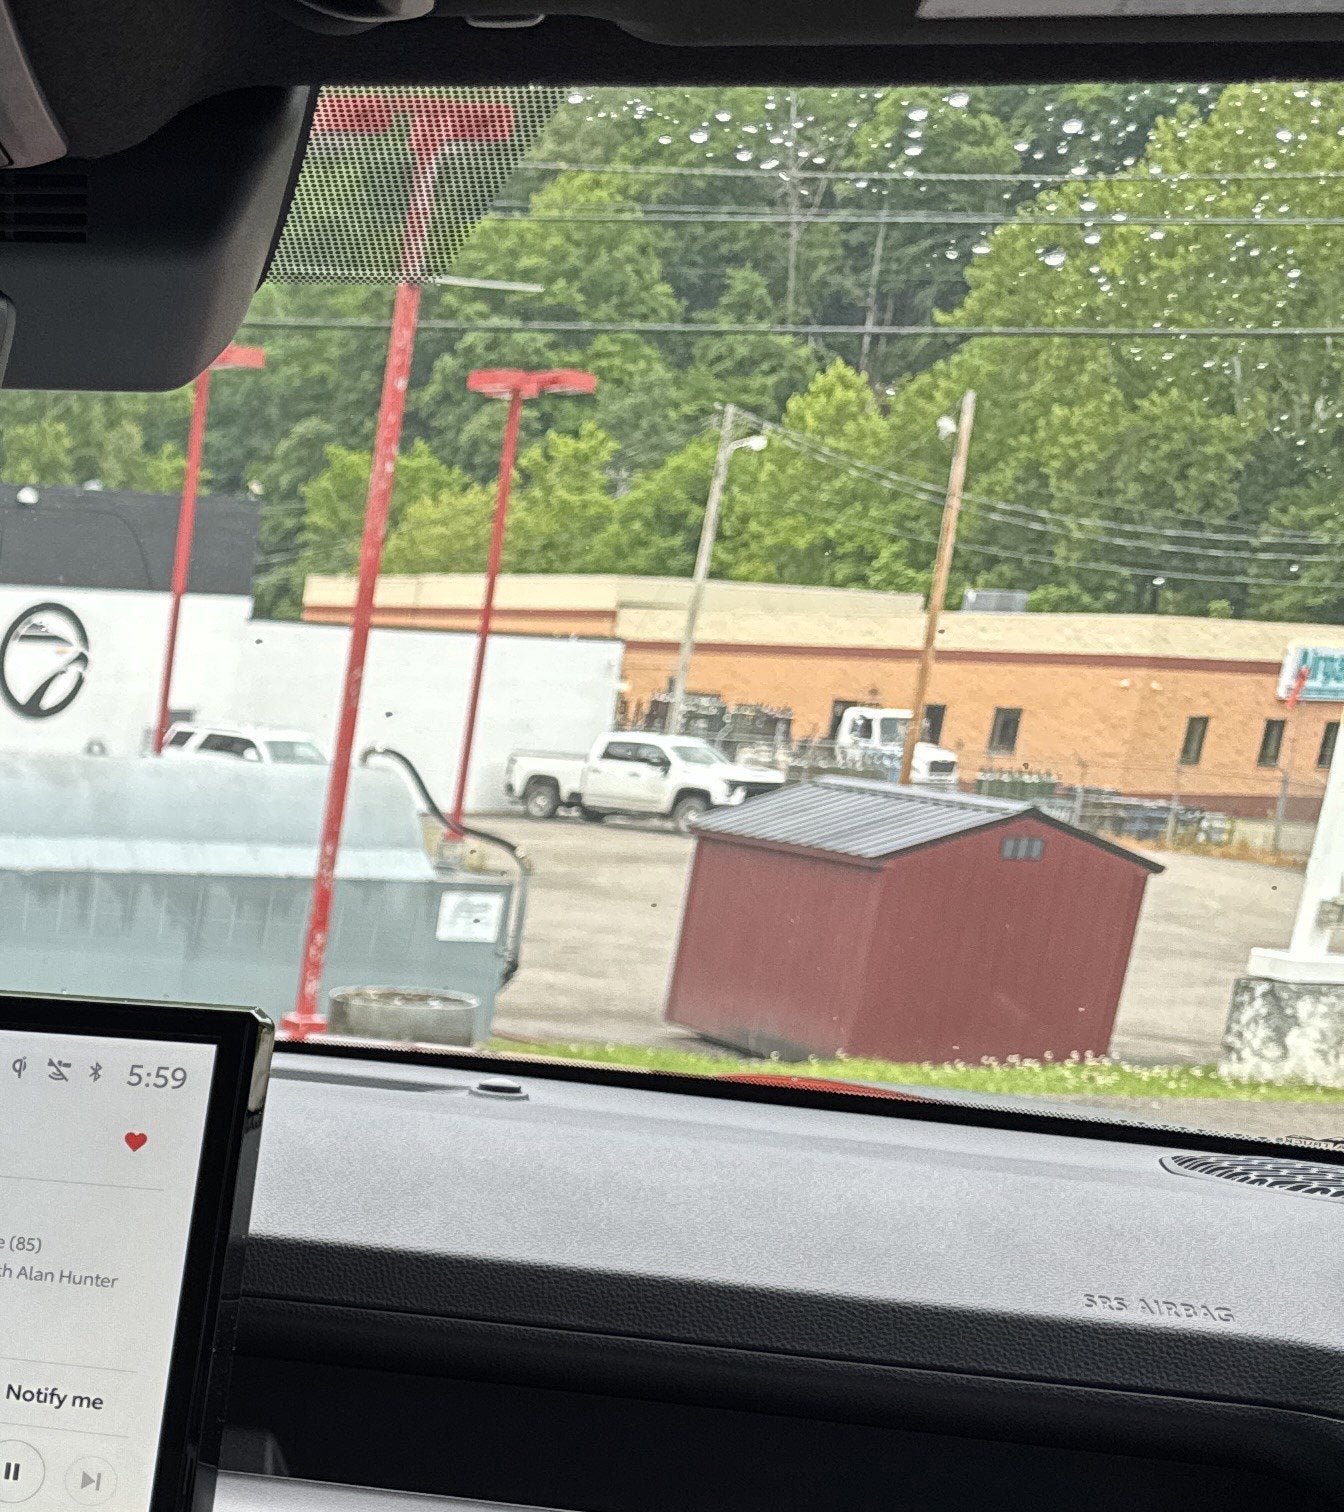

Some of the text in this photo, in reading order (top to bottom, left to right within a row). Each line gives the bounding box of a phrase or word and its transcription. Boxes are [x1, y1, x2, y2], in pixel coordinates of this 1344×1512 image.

[126, 1064, 188, 1090] 5:59
[9, 1235, 43, 1255] (85)
[16, 1265, 55, 1283] Alan
[59, 1270, 119, 1290] Hunter
[1083, 1293, 1235, 1322] SRS AIRBAG
[5, 1384, 105, 1411] Notify me
